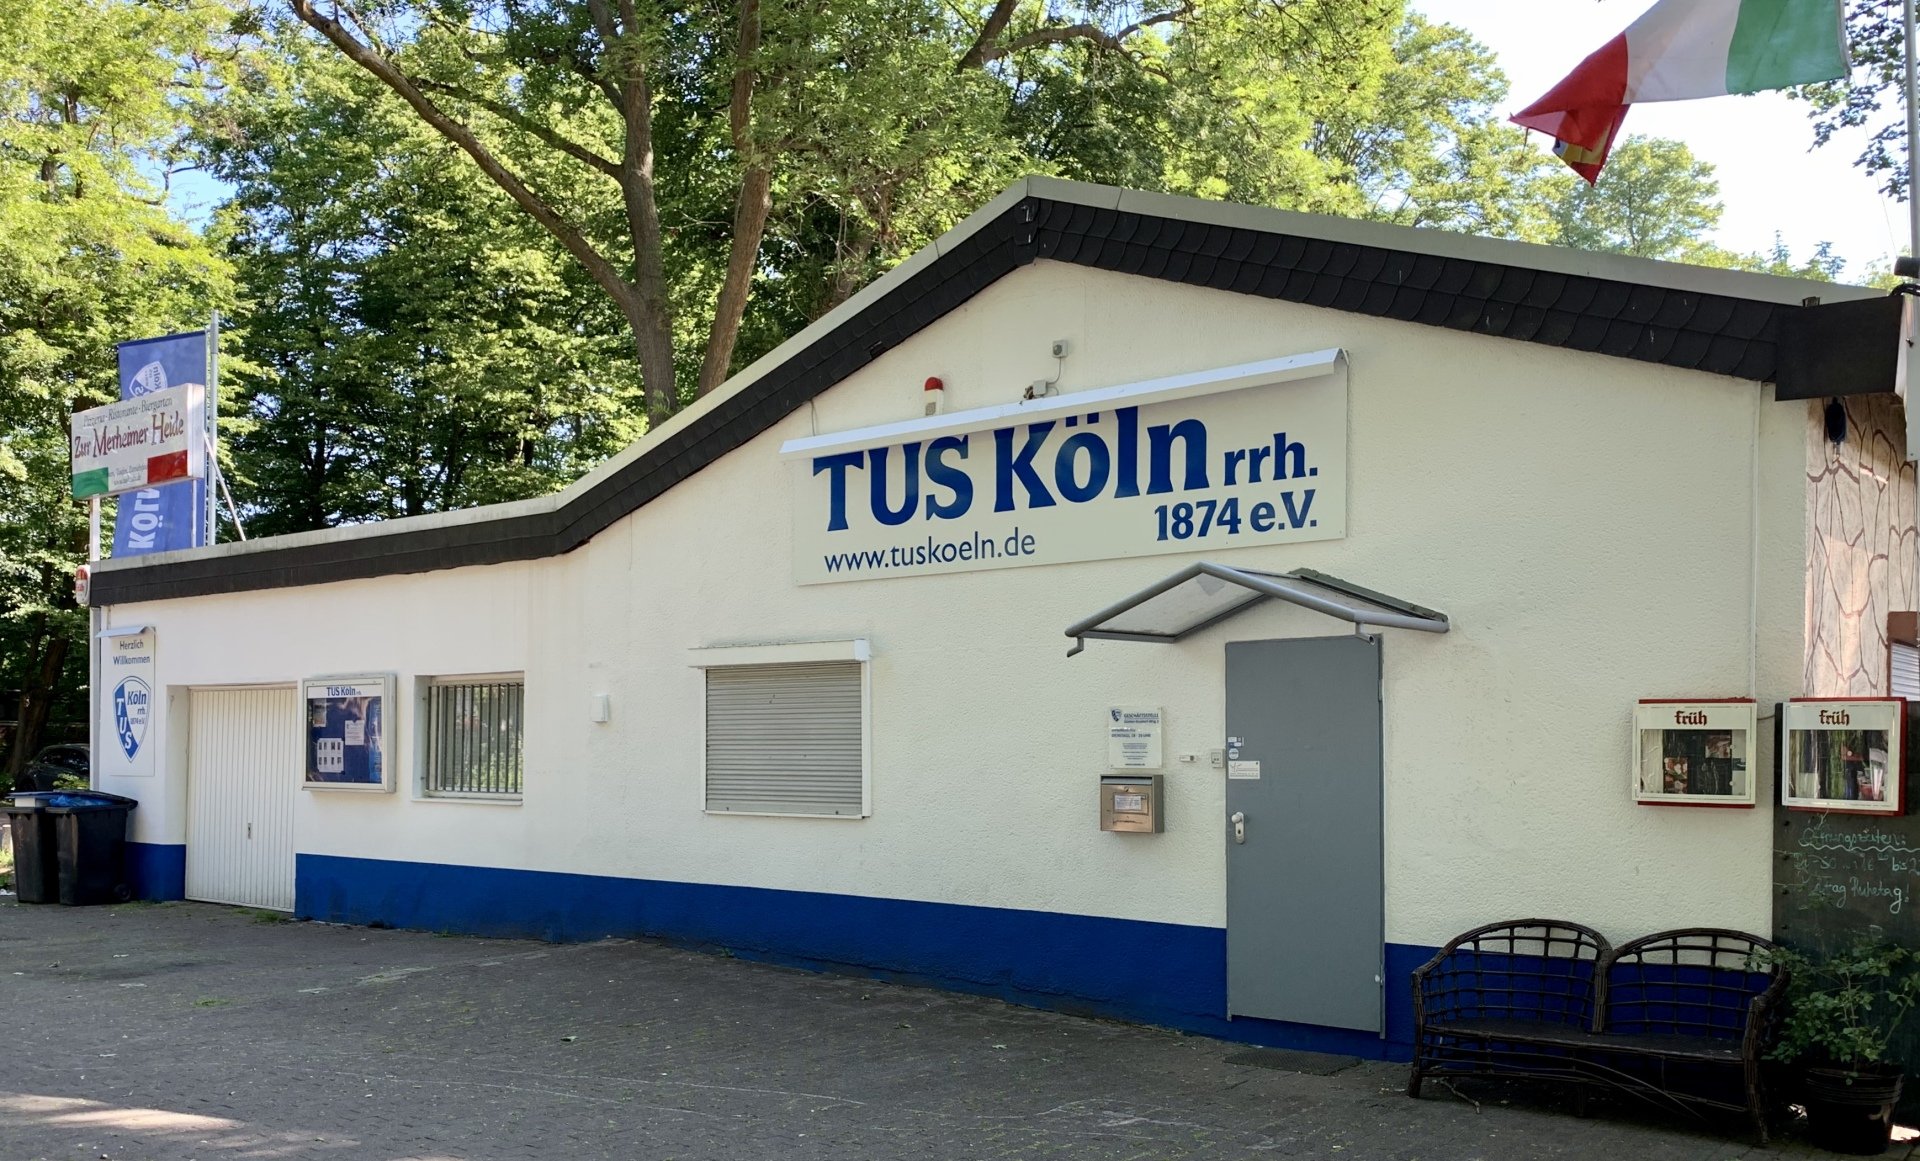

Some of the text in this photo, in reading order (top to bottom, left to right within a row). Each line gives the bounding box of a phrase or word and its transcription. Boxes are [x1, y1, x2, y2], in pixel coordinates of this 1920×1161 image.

[141, 397, 173, 413] Biergarten
[74, 410, 184, 459] Zur Merheimer Heide
[813, 406, 1318, 532] TUS Köln rrh.
[1154, 489, 1317, 541] 1874 e.V.
[824, 526, 1035, 573] www.tuskoeln.de
[119, 640, 144, 651] Herzlich
[113, 655, 151, 665] Willkommen
[127, 689, 147, 706] Köln
[326, 686, 340, 696] TUS
[341, 685, 356, 696] Köln
